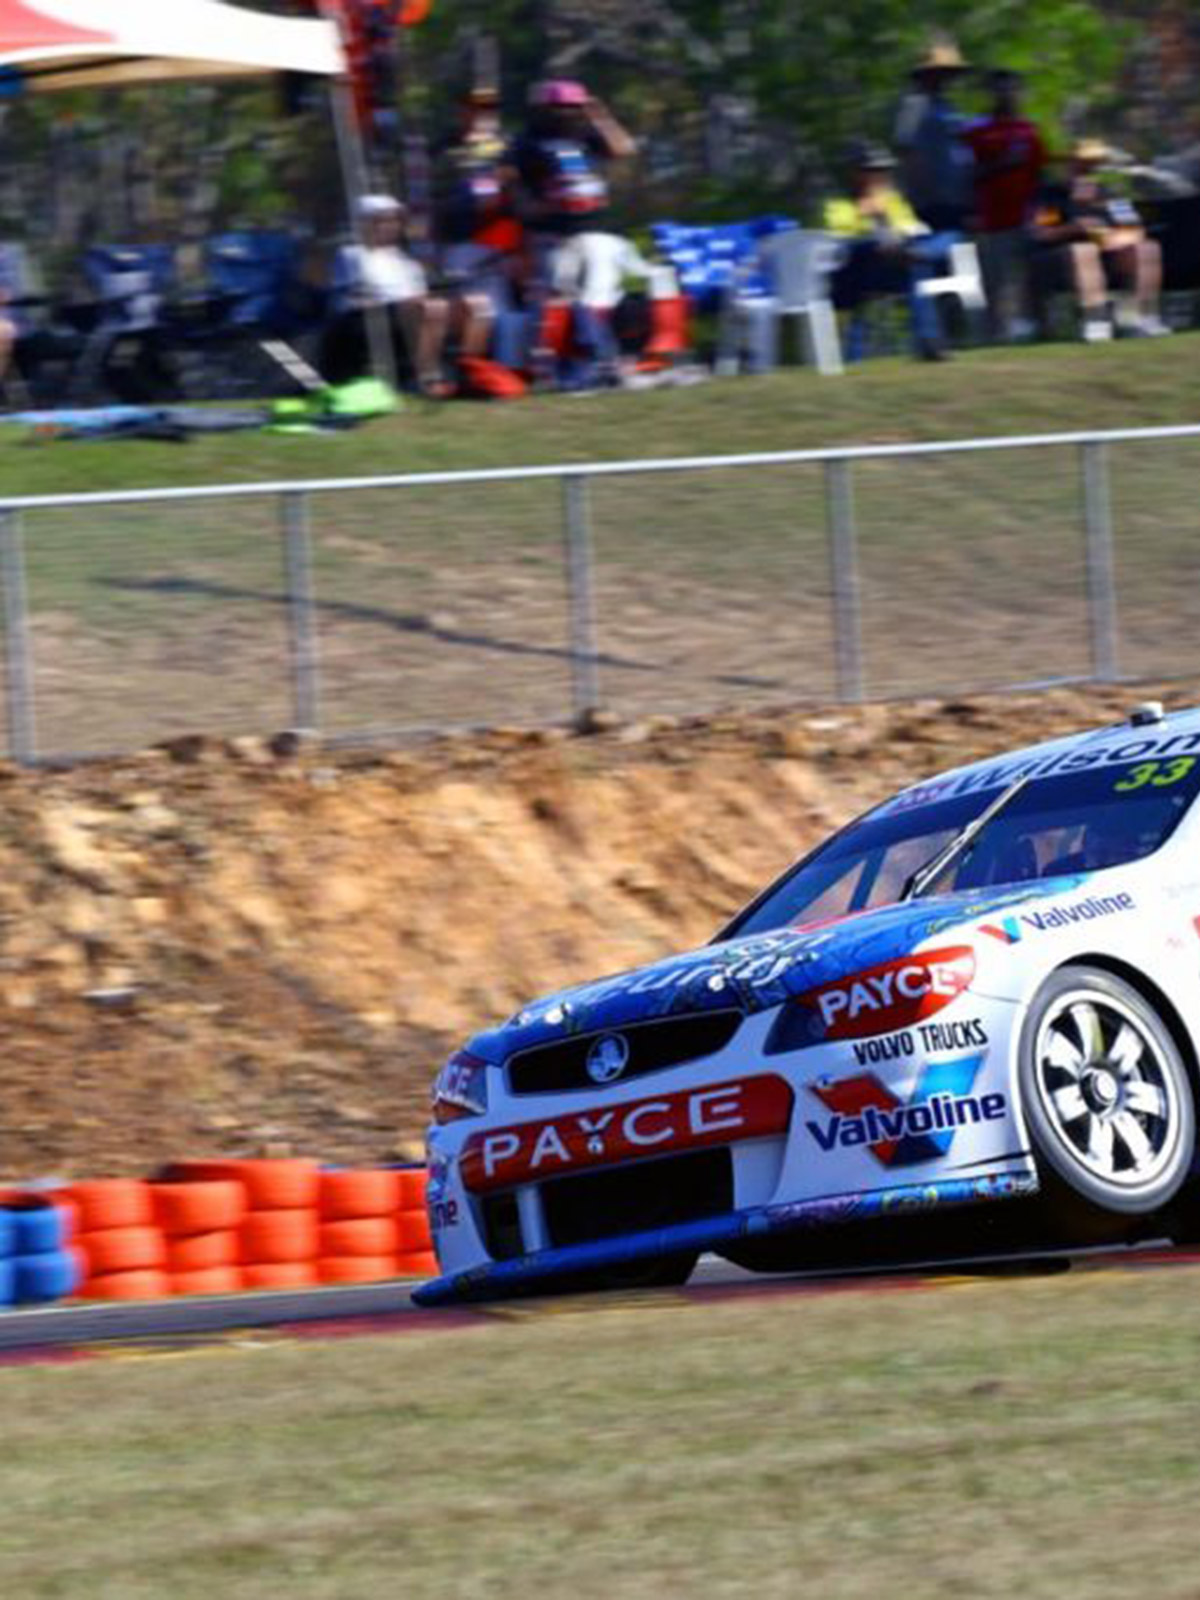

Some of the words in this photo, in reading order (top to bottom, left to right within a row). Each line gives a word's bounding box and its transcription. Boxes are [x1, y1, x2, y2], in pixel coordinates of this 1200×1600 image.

[1113, 756, 1196, 792] 33
[1021, 890, 1135, 931] Valvoline
[817, 961, 962, 1026] PAYCE
[853, 1031, 914, 1065] VOLVO
[919, 1018, 989, 1049] TRUCKS
[483, 1084, 745, 1178] PAYCE
[805, 1091, 1007, 1152] Valvoline
